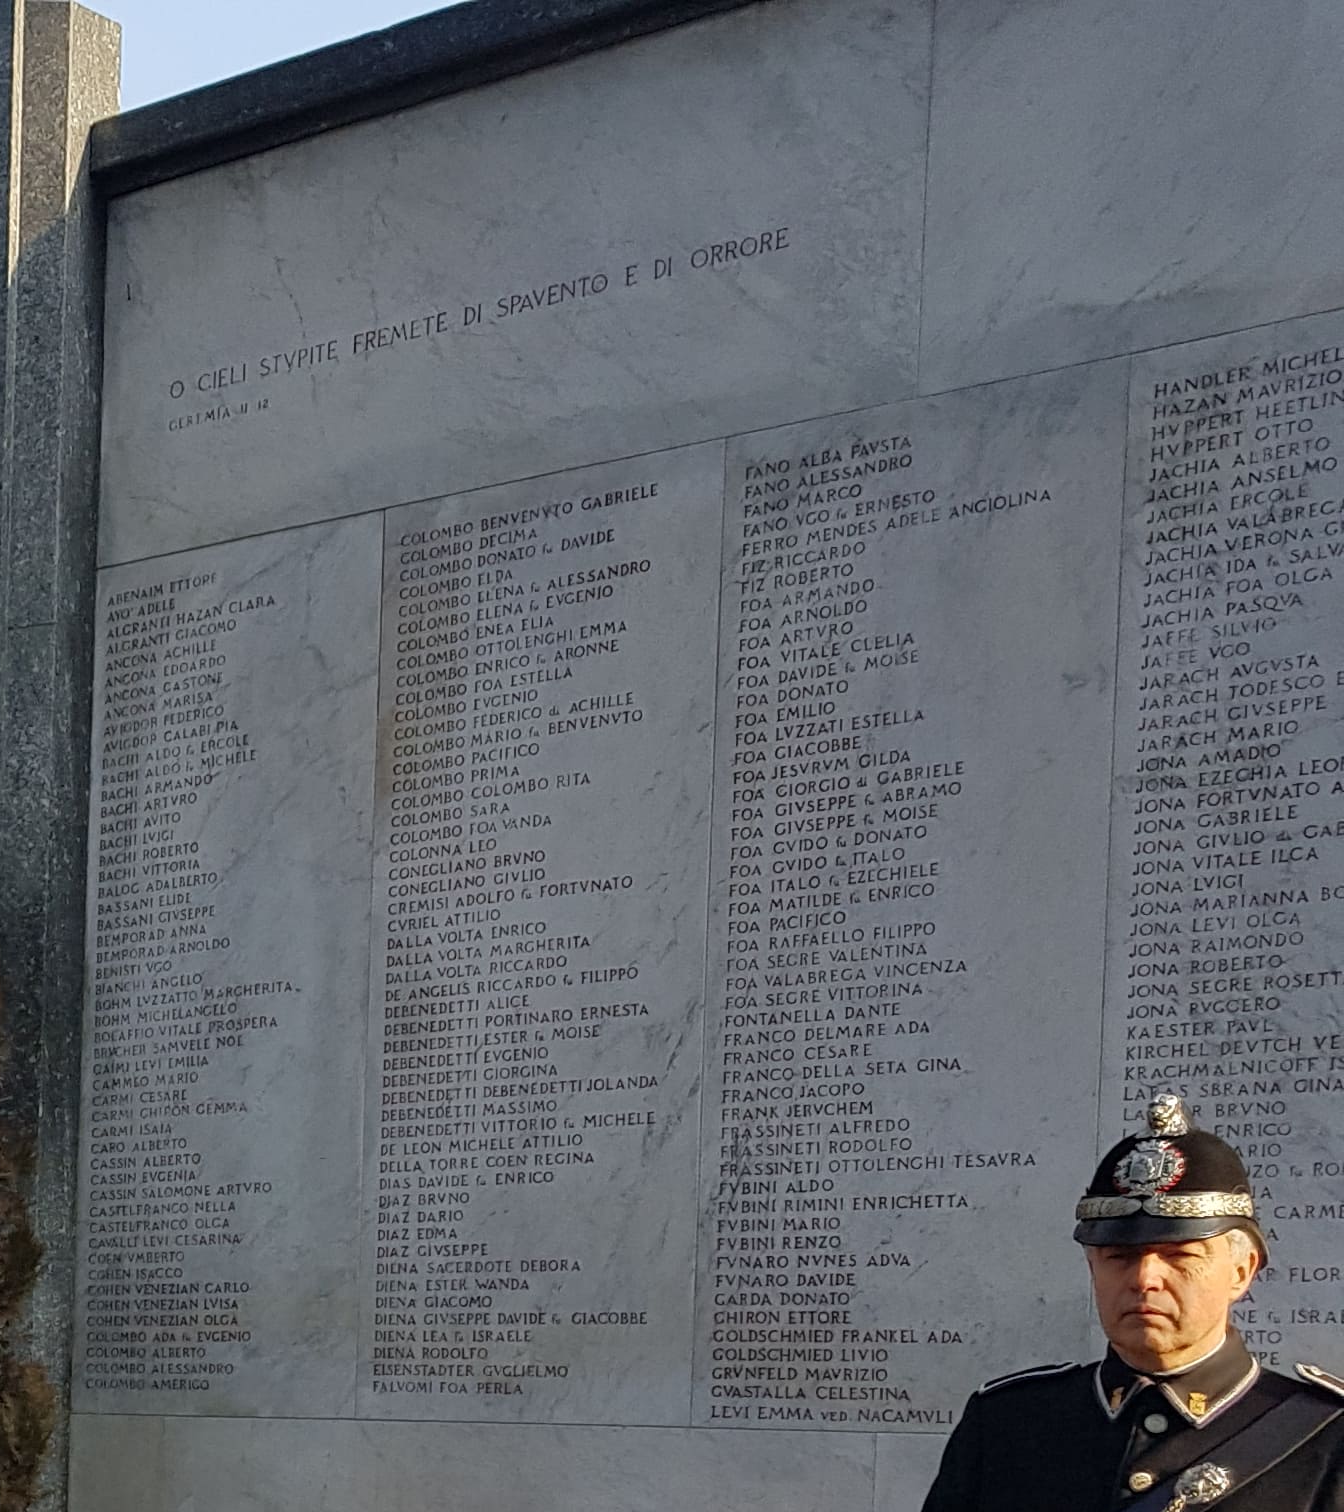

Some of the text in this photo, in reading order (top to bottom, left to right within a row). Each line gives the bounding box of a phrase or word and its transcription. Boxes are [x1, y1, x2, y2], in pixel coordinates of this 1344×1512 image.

[169, 380, 185, 399] O
[198, 363, 247, 392] CIELI
[353, 312, 449, 354] FREMETE
[463, 303, 482, 326] DI
[497, 273, 609, 318] SPAVENTO
[625, 265, 639, 287] E
[654, 257, 672, 280] DI
[690, 227, 790, 269] ORRORE
[1152, 390, 1227, 420] HAZAN
[1254, 416, 1313, 443] OTTO
[1149, 435, 1330, 484] JACHIA ALBERTO
[744, 454, 912, 500] FANO ALESSANDRO
[743, 482, 862, 518] FANO MARCO
[1147, 481, 1307, 525] JACHIA ERCOLE
[399, 526, 537, 566] COLOMBO DECIMA
[739, 561, 854, 594] FIZ ROBERTO
[738, 599, 867, 634] FOA ARNOLDO
[1141, 603, 1214, 630] JACHIA
[396, 613, 553, 653] COLOMBO ENEA ELIA
[737, 630, 914, 671] FOA VITALE CLELIA
[736, 679, 848, 709] FOA DONATO
[734, 728, 767, 747] FOA
[850, 707, 924, 731] ESTELLA
[1137, 718, 1298, 753] JARACH MARIO
[1136, 741, 1281, 774] JONA AMADIO
[390, 771, 590, 811] COLOMBO COLOMBO RITA
[100, 801, 137, 818] BACHI
[1133, 803, 1297, 835] JONA GABRIELE
[99, 811, 181, 834] BACHI AVITO
[98, 842, 199, 866] BACHI ROBERTO
[389, 838, 497, 863] COLONNA LEO
[98, 858, 199, 883] BACHI VITTORIA
[1131, 877, 1183, 897] JONA
[97, 892, 189, 914] BASSANI ELIDE
[96, 924, 206, 947] BEMPORAD ANNA
[726, 921, 936, 953] FOA RAFFAELLO FILIPPO
[1128, 928, 1304, 958] JONA RAIMONDO
[95, 938, 230, 963] BEMPORAD ARNOLDO
[385, 955, 567, 984] DALLA VOLTA RICCARDO
[1127, 952, 1286, 979] JONA ROBERTO
[384, 994, 529, 1019] DEBENEDETTI ALICE
[724, 1002, 900, 1028] FONTANELLA DANTE
[1126, 1019, 1215, 1040] KAESTER
[381, 1099, 557, 1121] DEBENEDETTI MASSIMO
[720, 1119, 910, 1140] FRASSINETI ALFREDO
[379, 1134, 583, 1156] DE LEON MICHELE ATTILIO
[90, 1153, 201, 1170] CASSIN ALBERTO
[719, 1159, 820, 1177] FRASSINETI
[827, 1155, 944, 1173] OTTOLENGHI
[89, 1187, 136, 1201] CASSIN
[141, 1184, 210, 1199] SALOMONE
[378, 1194, 410, 1208] DIAZ
[783, 1197, 844, 1212] RIMINI
[852, 1193, 968, 1211] ENRICHETTA
[377, 1209, 463, 1224] DIAZ DARIO
[376, 1226, 457, 1240] DIAZ EDMA
[781, 1235, 841, 1250] RENZO
[375, 1261, 418, 1275] DIENA
[519, 1259, 580, 1273] DEBORA
[135, 1283, 199, 1296] VENEZIAN
[204, 1282, 249, 1295] CARLO
[796, 1273, 856, 1287] DAVIDE
[85, 1347, 205, 1359] COLOMBO ALBERTO
[373, 1346, 415, 1359] DIENA
[815, 1386, 911, 1402] CELESTINA
